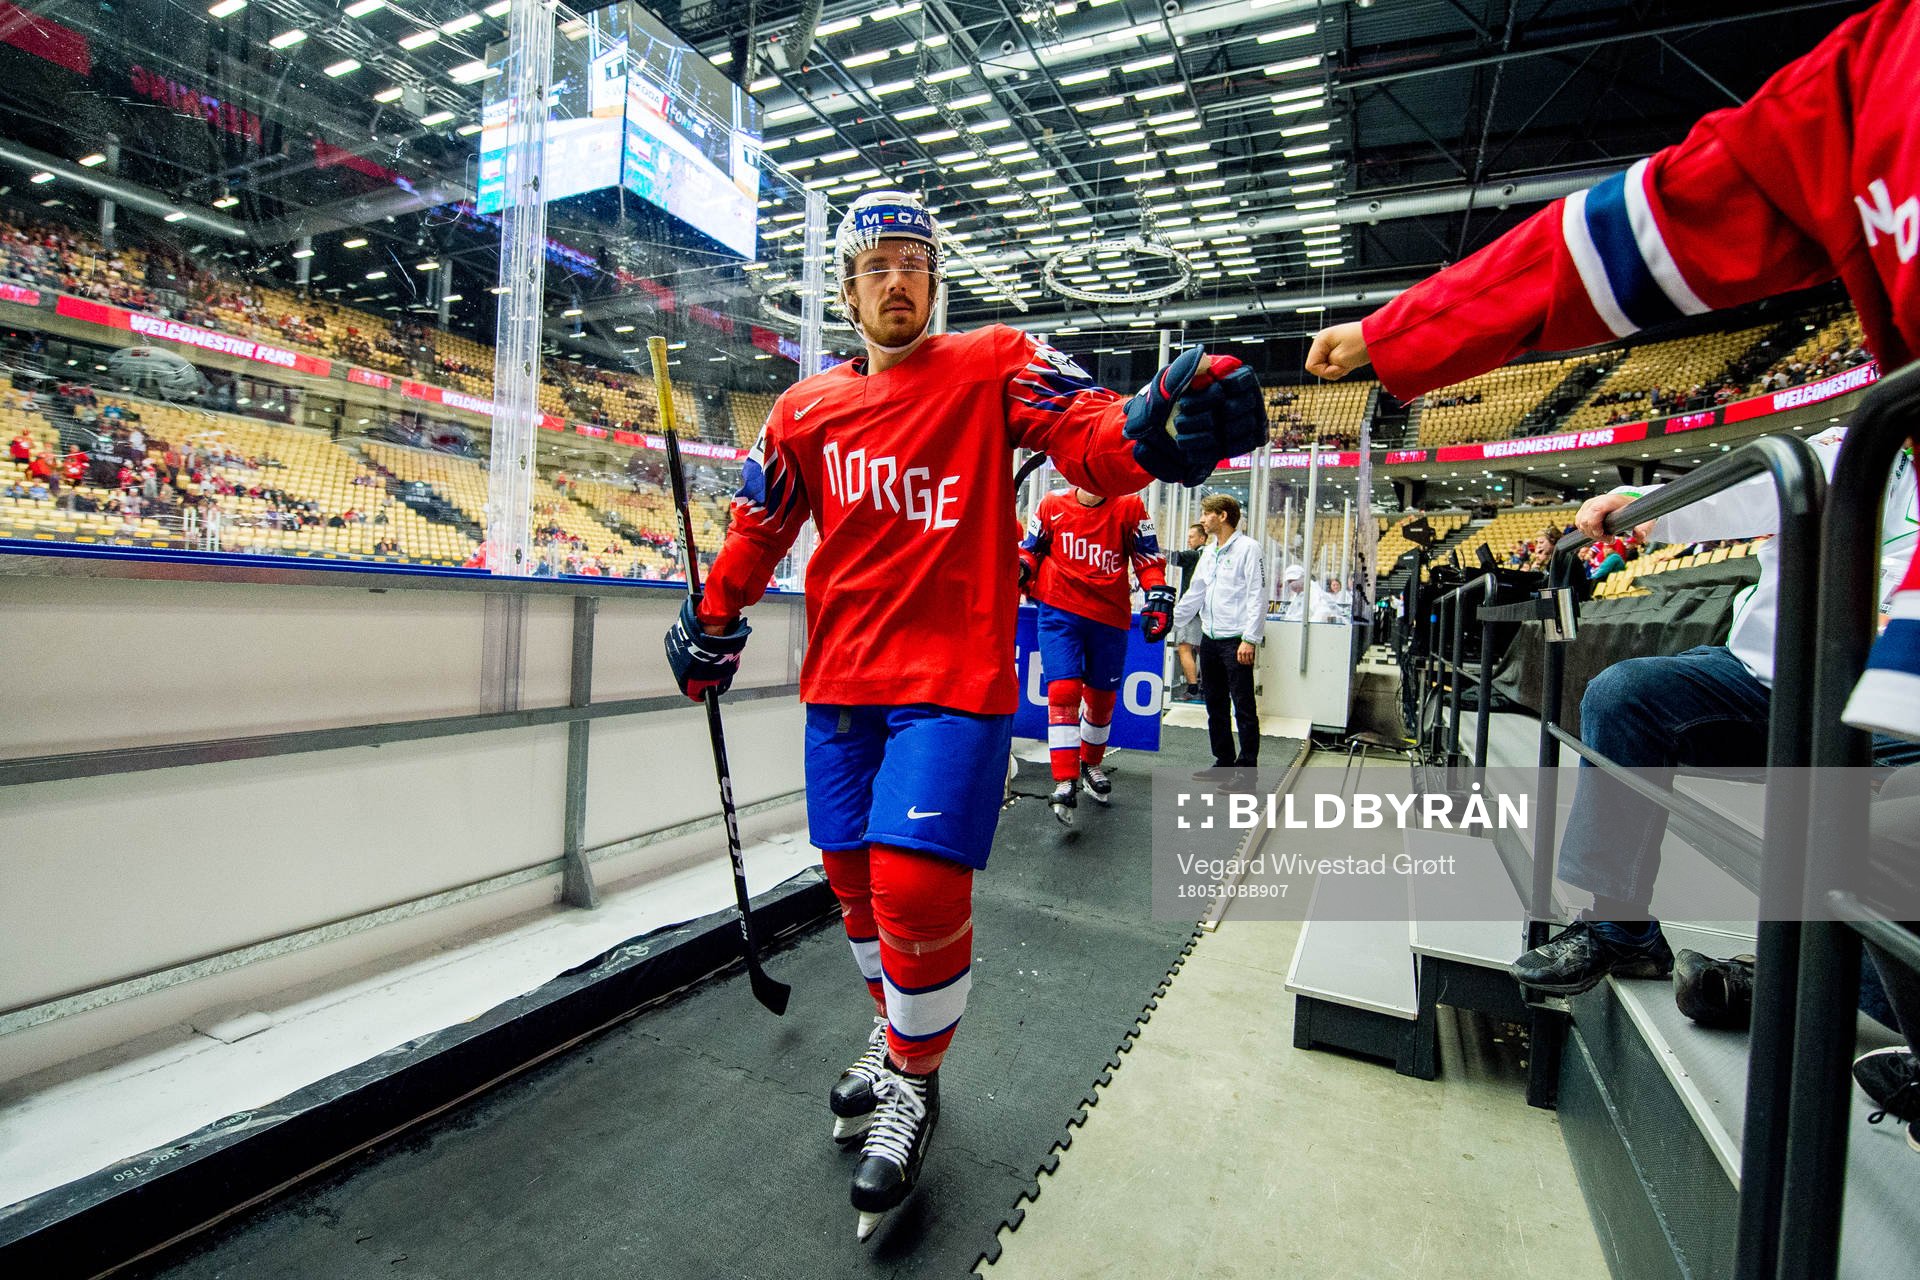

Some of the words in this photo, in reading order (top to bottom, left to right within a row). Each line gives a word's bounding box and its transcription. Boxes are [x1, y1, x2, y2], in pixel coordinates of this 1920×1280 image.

[255, 344, 297, 367] FANS
[1578, 429, 1614, 447] FANS
[823, 441, 961, 534] NORGE
[1061, 532, 1121, 575] NORGE
[721, 776, 746, 877] CCM
